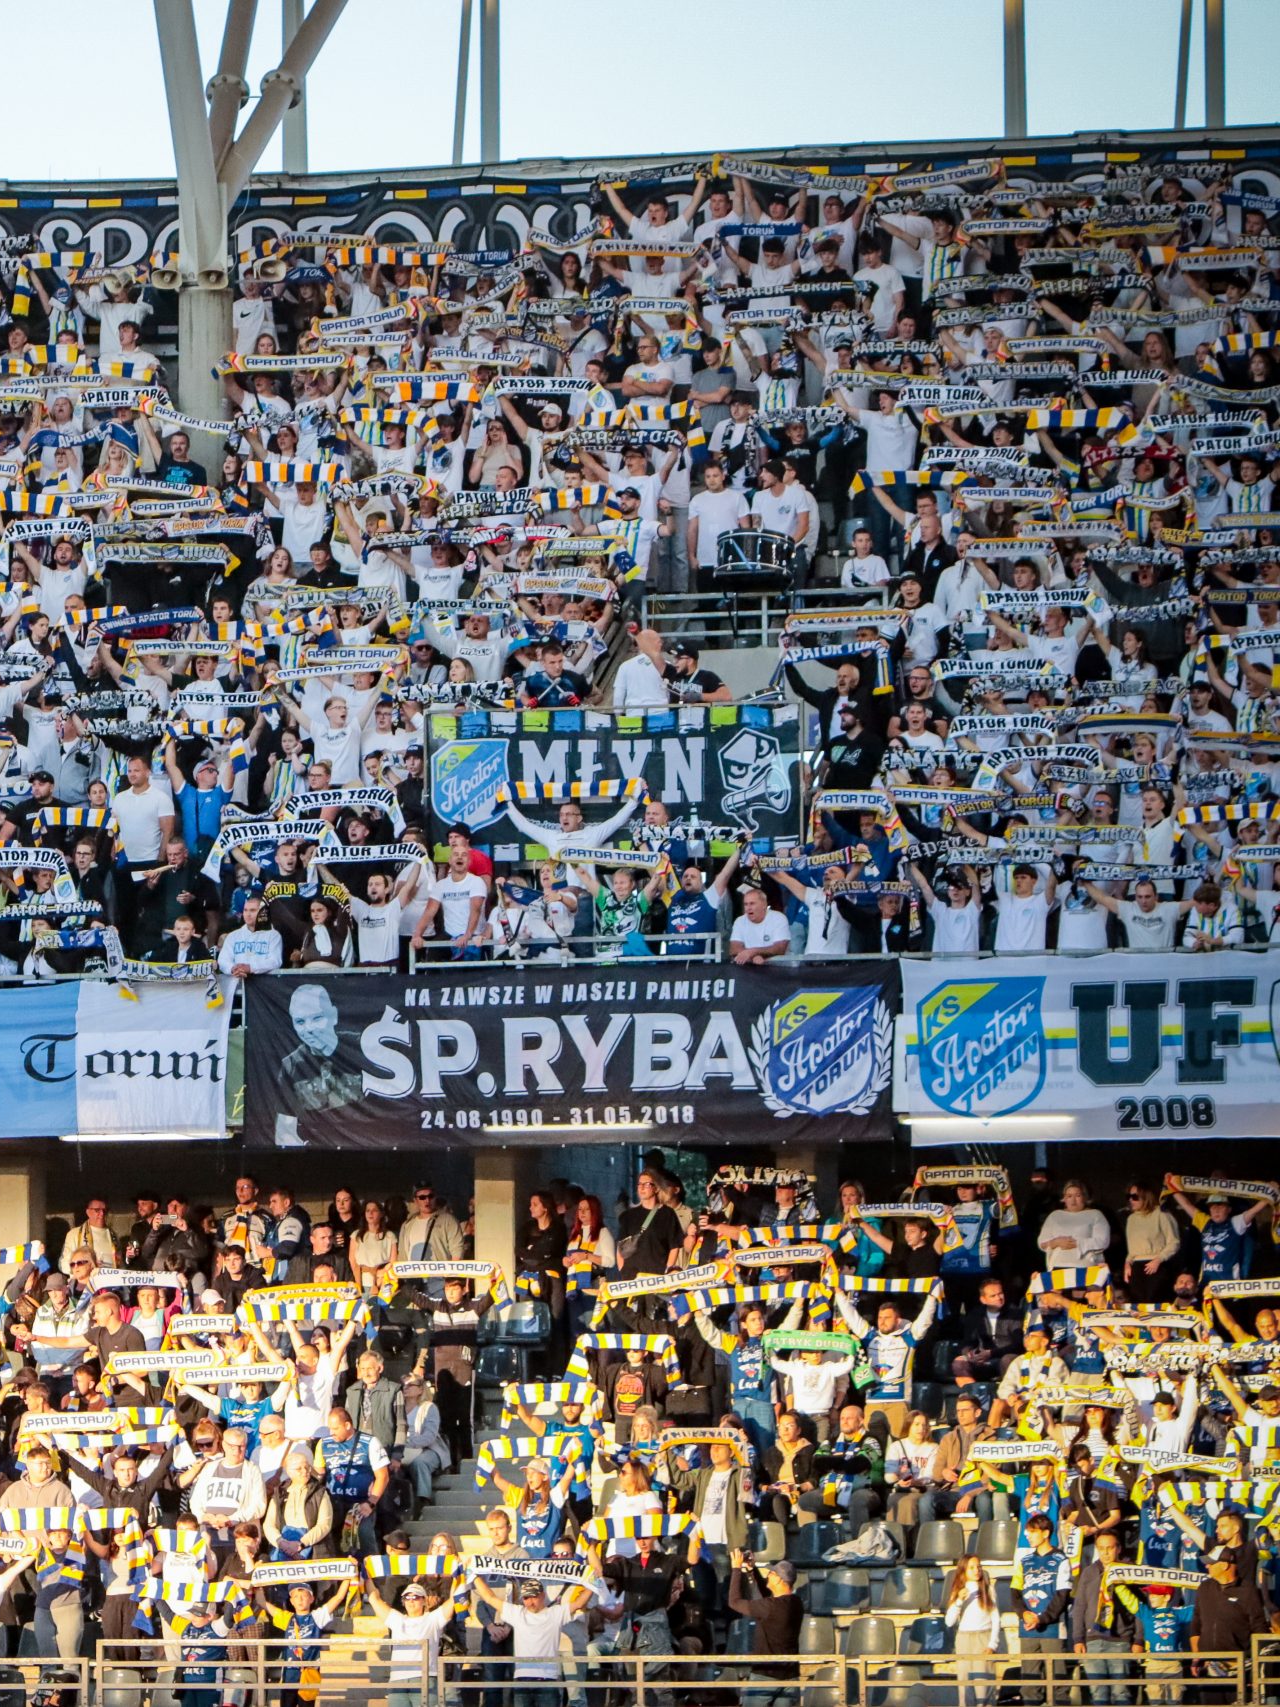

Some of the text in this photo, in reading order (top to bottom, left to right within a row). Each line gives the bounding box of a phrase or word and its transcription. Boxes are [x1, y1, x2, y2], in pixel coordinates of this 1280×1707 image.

[320, 316, 365, 334] APATOR
[246, 356, 297, 368] APATOR
[135, 642, 184, 654] APATOR
[306, 647, 356, 659] APATOR
[437, 751, 460, 777] KS
[519, 736, 707, 804] MŁYN
[318, 846, 374, 859] PATOR
[404, 978, 736, 1007] NA ZAWSZE W NASZEJ PAMIĘCI
[776, 1003, 809, 1035] KS
[925, 993, 961, 1037] KS
[779, 1008, 870, 1092] Apator
[931, 1001, 1035, 1097] Apator
[20, 1032, 225, 1084] Toruń
[420, 1108, 543, 1130] 24.08.1990
[569, 1105, 696, 1126] 31.05.2018
[1116, 1095, 1217, 1131] 2008
[924, 1169, 976, 1181] APATOR
[1183, 1175, 1237, 1190] APATOR
[608, 1278, 672, 1295] APATOR
[173, 1317, 216, 1330] PATOR
[114, 1355, 166, 1369] APATOR
[184, 1367, 239, 1380] APATOR
[25, 1415, 69, 1429] PATOR
[973, 1445, 1023, 1456] APATOR
